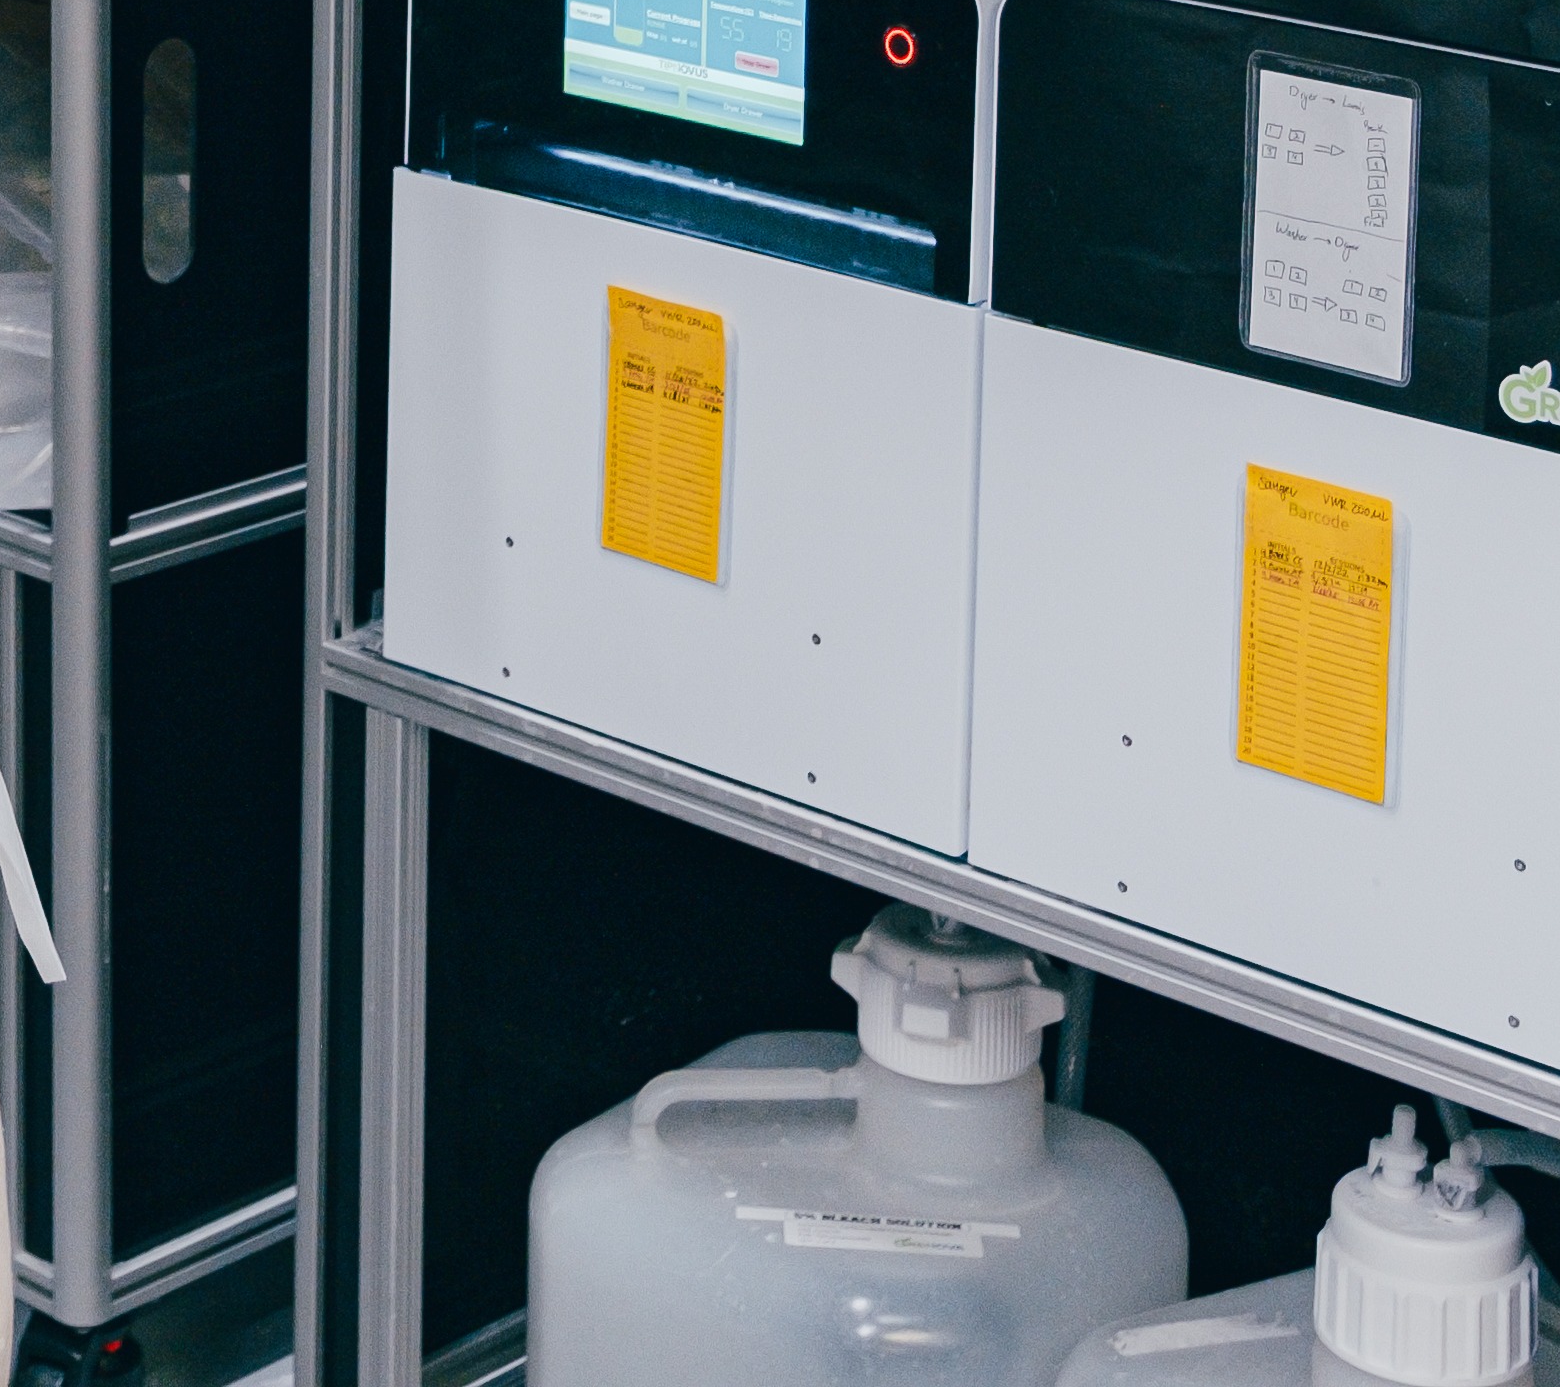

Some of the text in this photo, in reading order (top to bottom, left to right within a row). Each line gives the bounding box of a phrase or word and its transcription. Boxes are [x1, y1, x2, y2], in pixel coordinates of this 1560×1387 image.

[720, 15, 745, 43] 55
[722, 101, 764, 119] Dryer Drawer
[1287, 501, 1351, 532] Barcode
